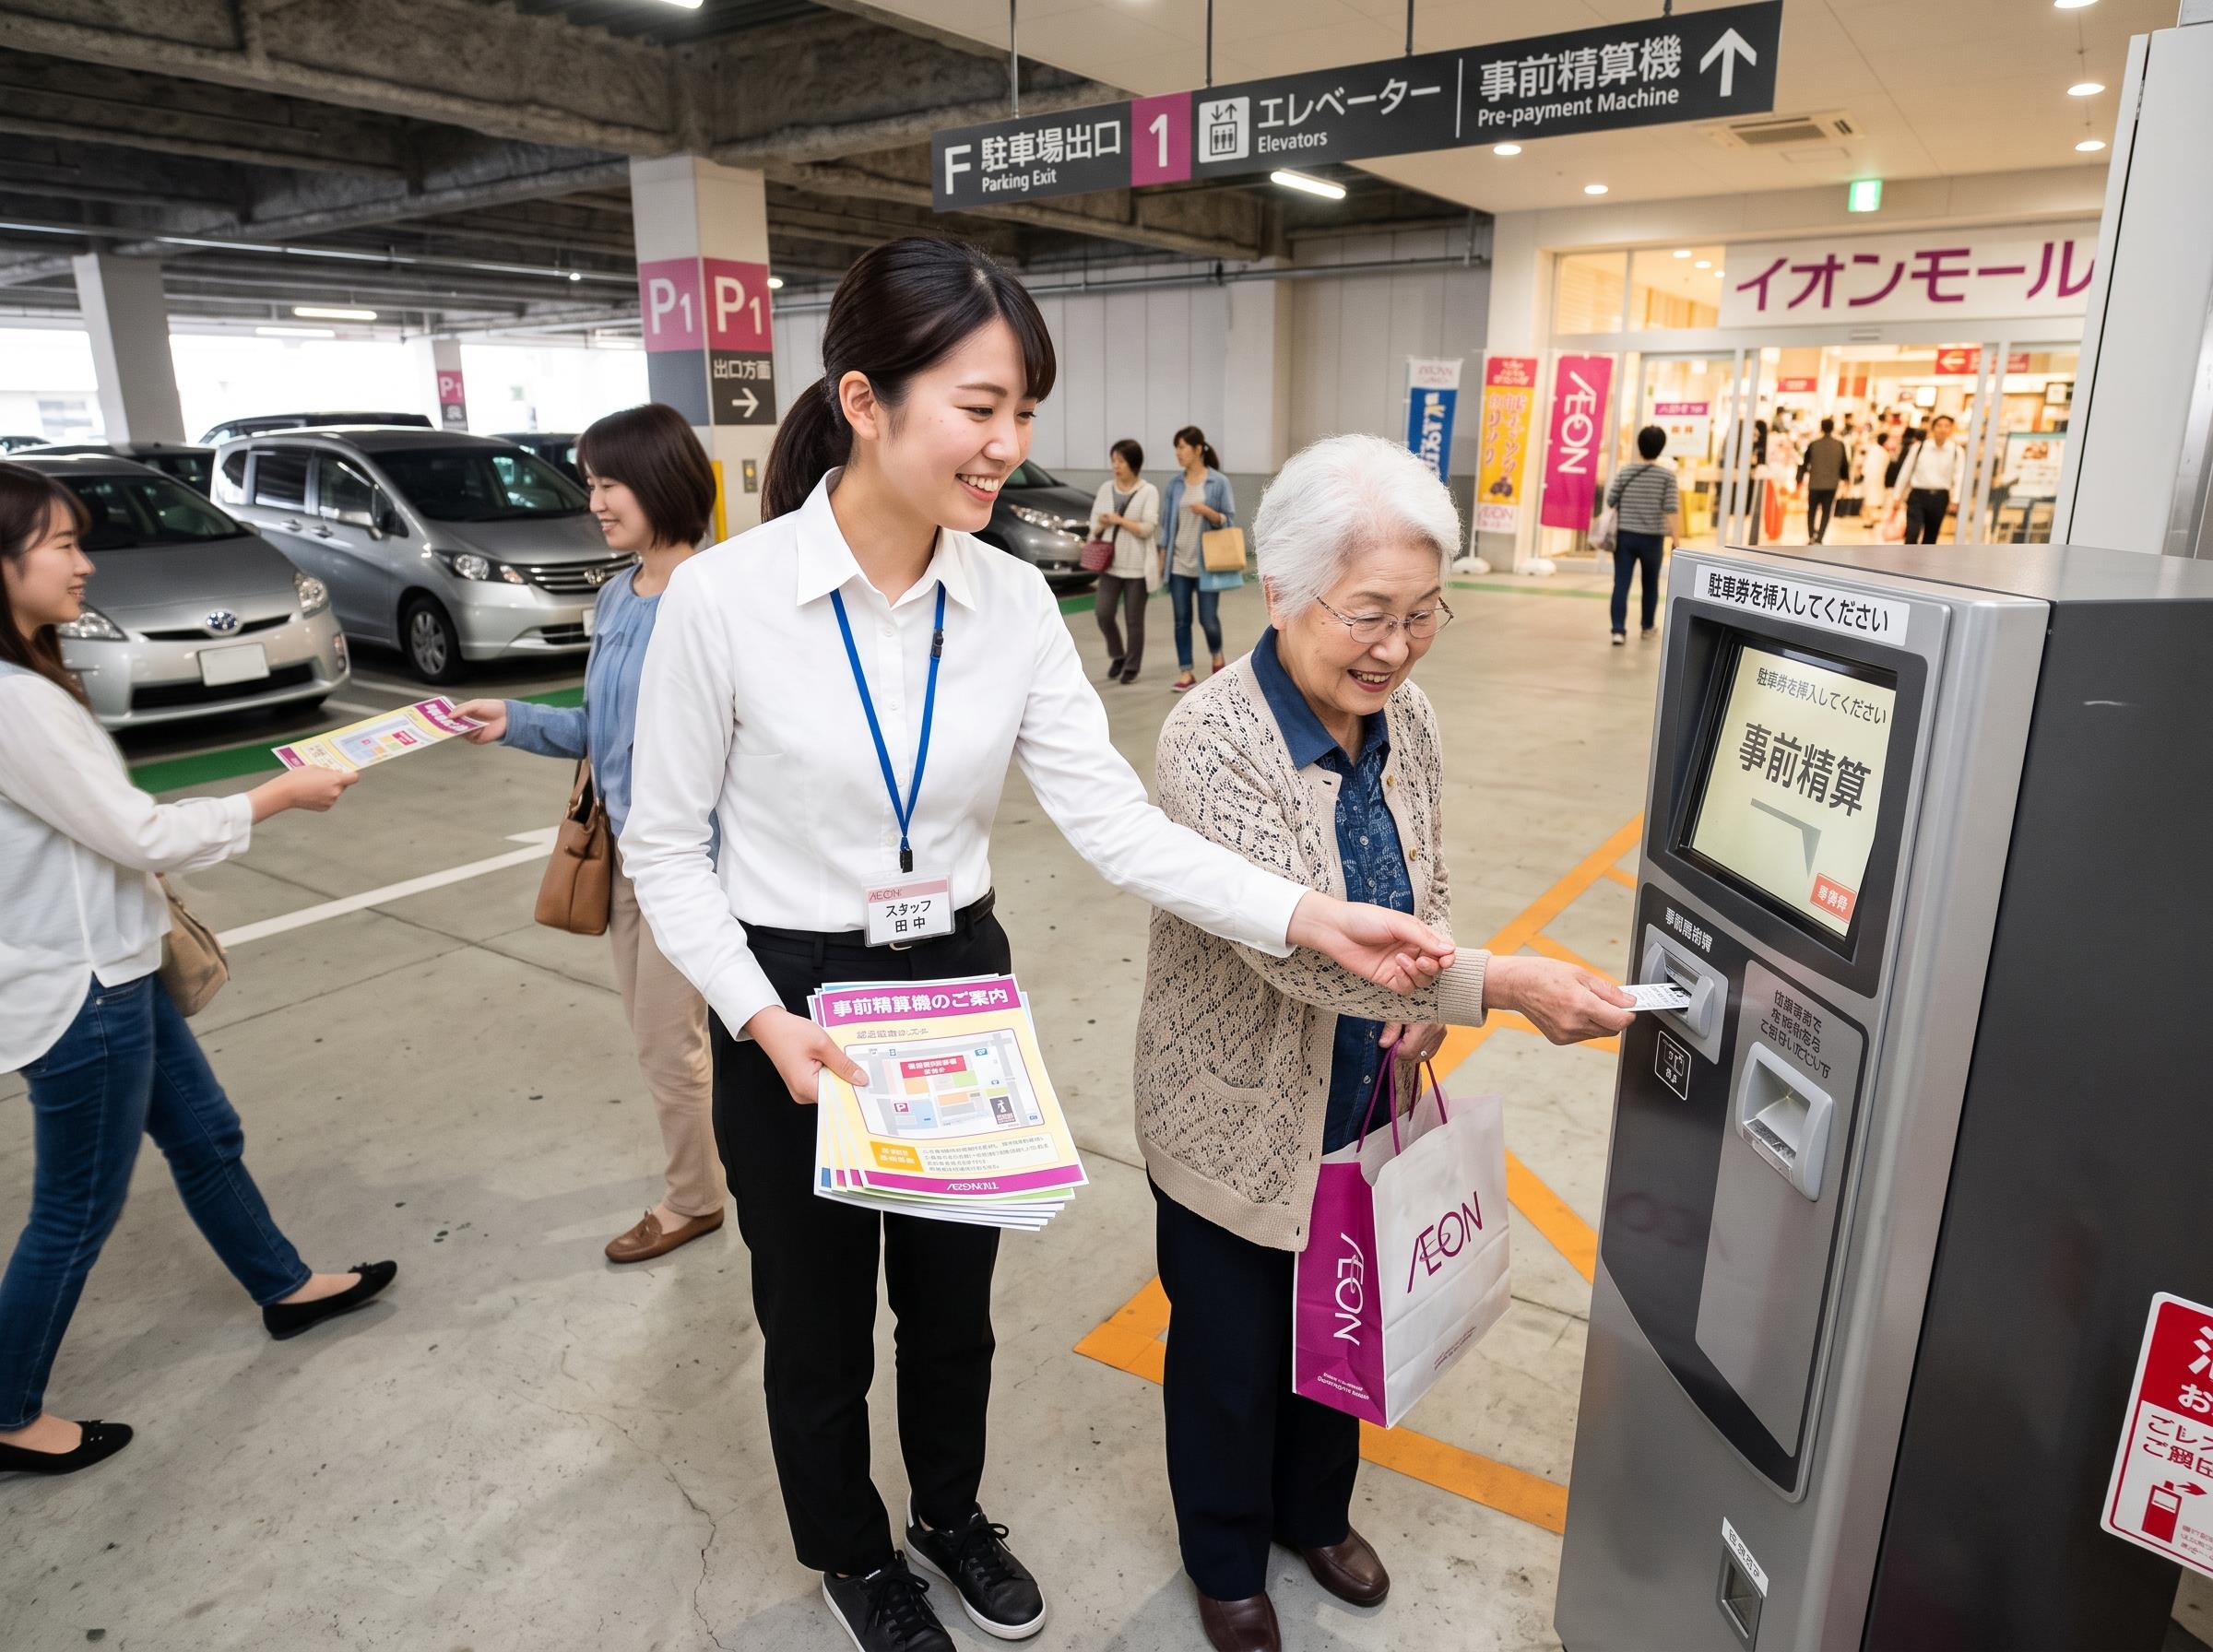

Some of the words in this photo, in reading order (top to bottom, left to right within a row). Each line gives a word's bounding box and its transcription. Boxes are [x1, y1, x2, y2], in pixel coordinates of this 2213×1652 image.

[1479, 34, 1682, 103] 事前精算機
[1258, 77, 1441, 129] エレベーター
[1477, 97, 1592, 127] Pre-payment
[1597, 87, 1679, 112] Machine
[981, 120, 1120, 172] 駐車場出口
[1148, 113, 1168, 168] 1
[1258, 131, 1328, 154] Elevators
[944, 145, 972, 195] F
[982, 171, 1029, 193] Parking
[1033, 169, 1057, 186] Exit
[1736, 241, 2094, 312] イオンモール
[648, 277, 692, 335] P1
[714, 276, 763, 335] P1
[1739, 722, 1871, 818] 事前精算
[885, 900, 931, 918] スタッフ
[833, 988, 1009, 1018] 事前精算機のご案内
